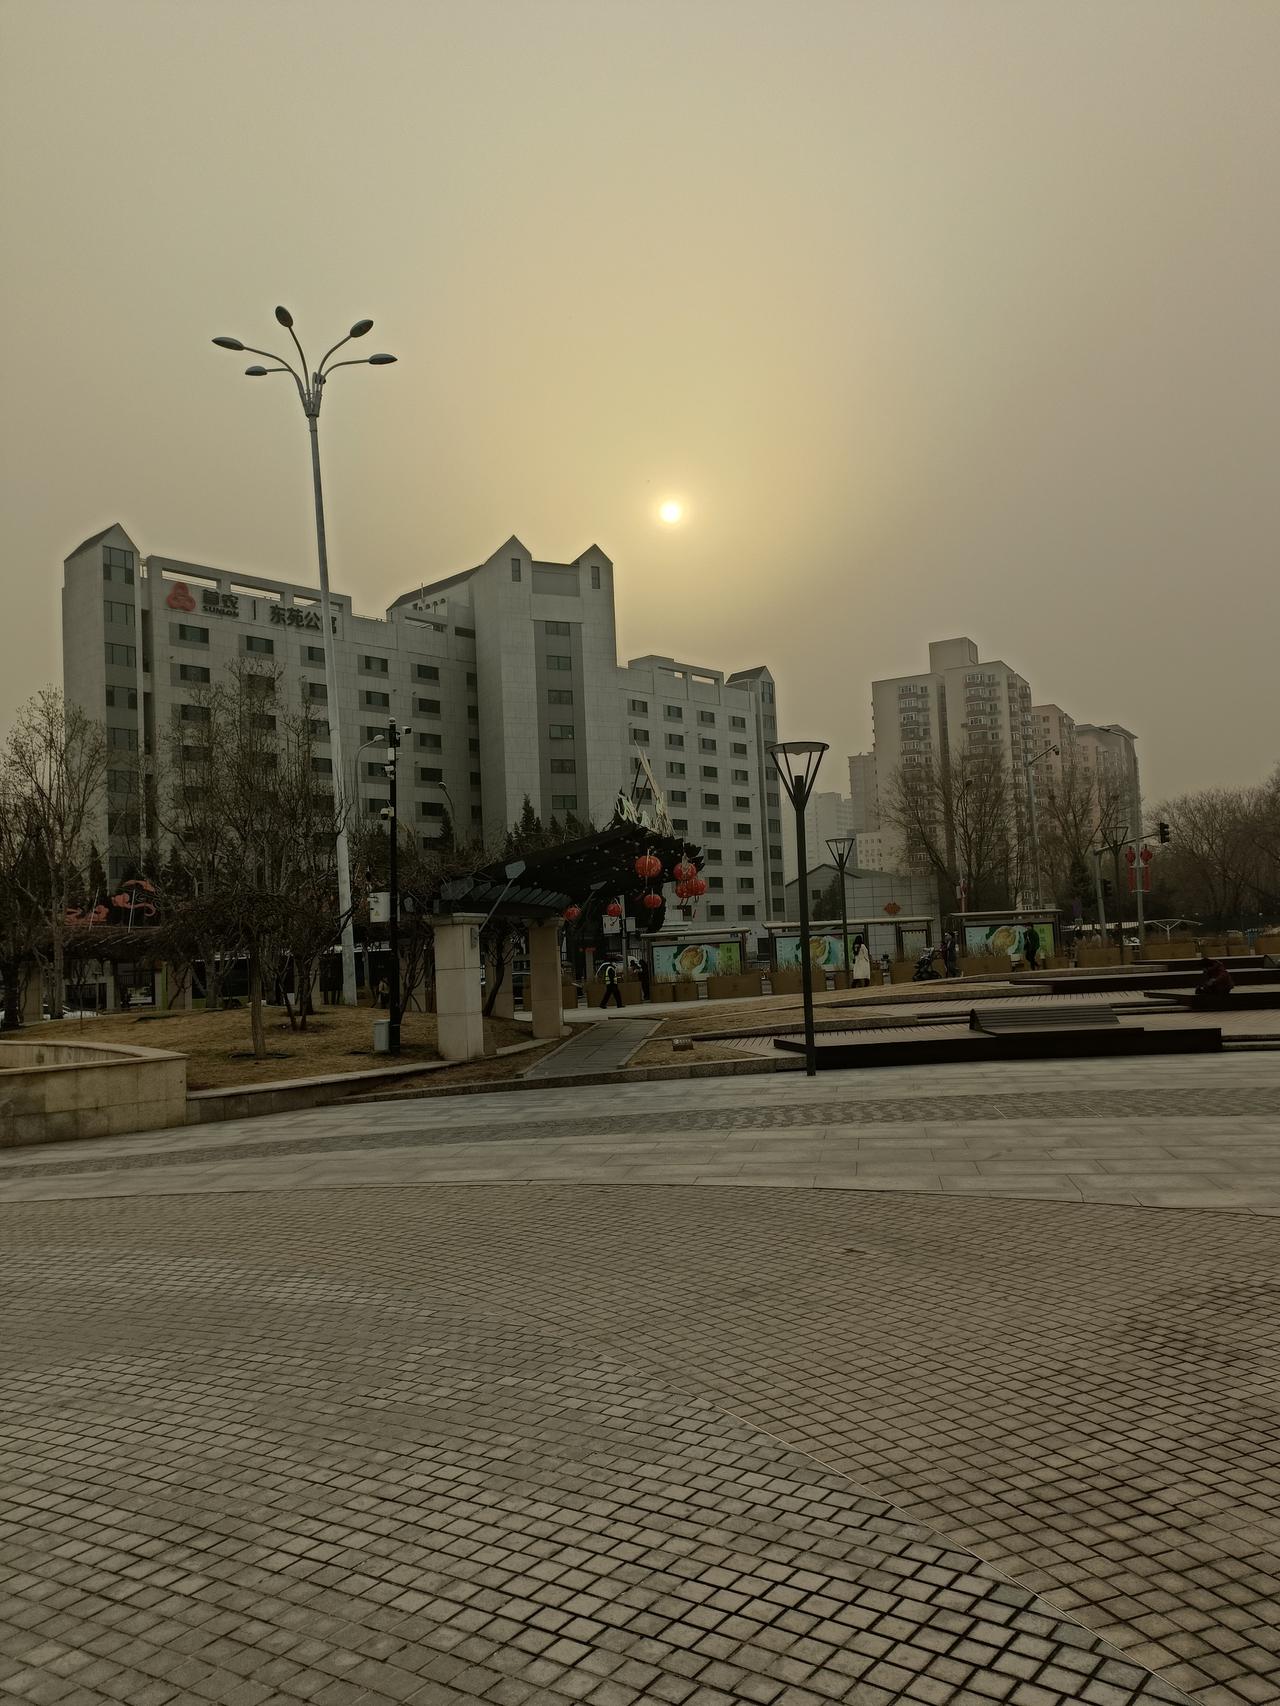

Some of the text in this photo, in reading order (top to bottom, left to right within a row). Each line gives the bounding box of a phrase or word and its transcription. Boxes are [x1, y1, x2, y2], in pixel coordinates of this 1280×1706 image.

[202, 605, 239, 617] SUNLON
[270, 604, 337, 634] 东苑公
